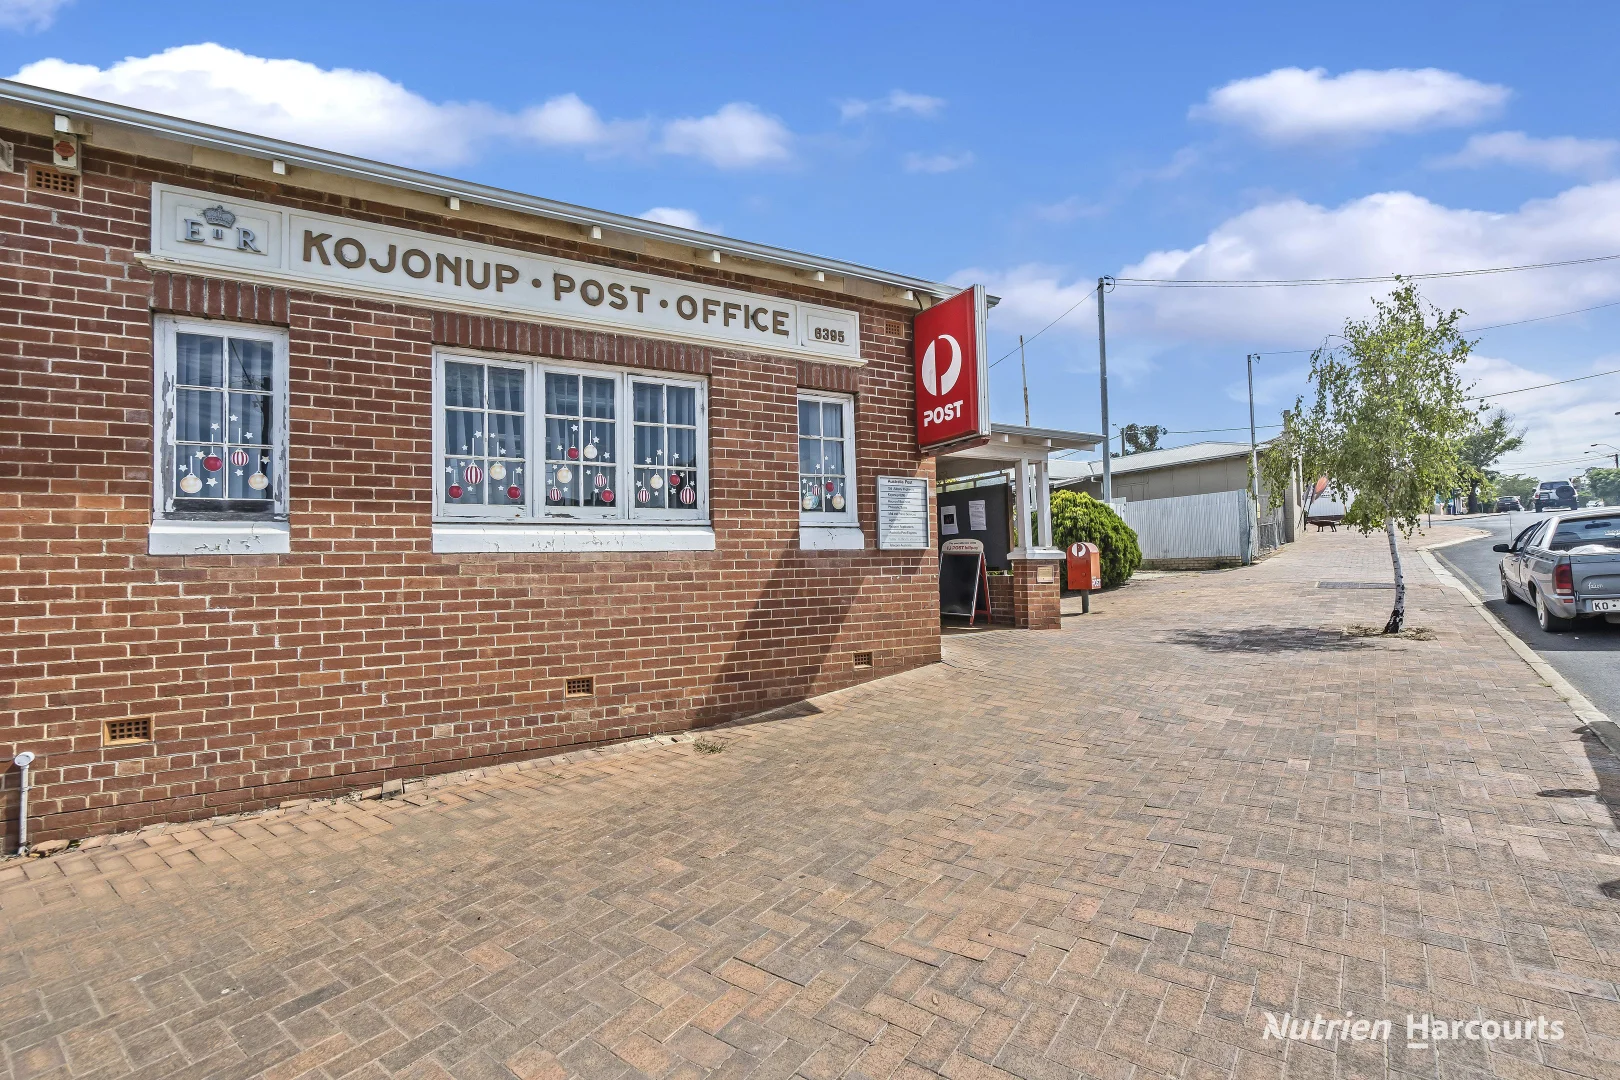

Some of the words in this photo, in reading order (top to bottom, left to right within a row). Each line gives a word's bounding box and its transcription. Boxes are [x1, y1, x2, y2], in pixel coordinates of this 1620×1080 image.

[303, 230, 520, 292] KOJONUP
[553, 272, 650, 313] POST
[676, 294, 790, 336] OFFICE
[814, 326, 845, 343] 6395
[923, 400, 964, 427] POST
